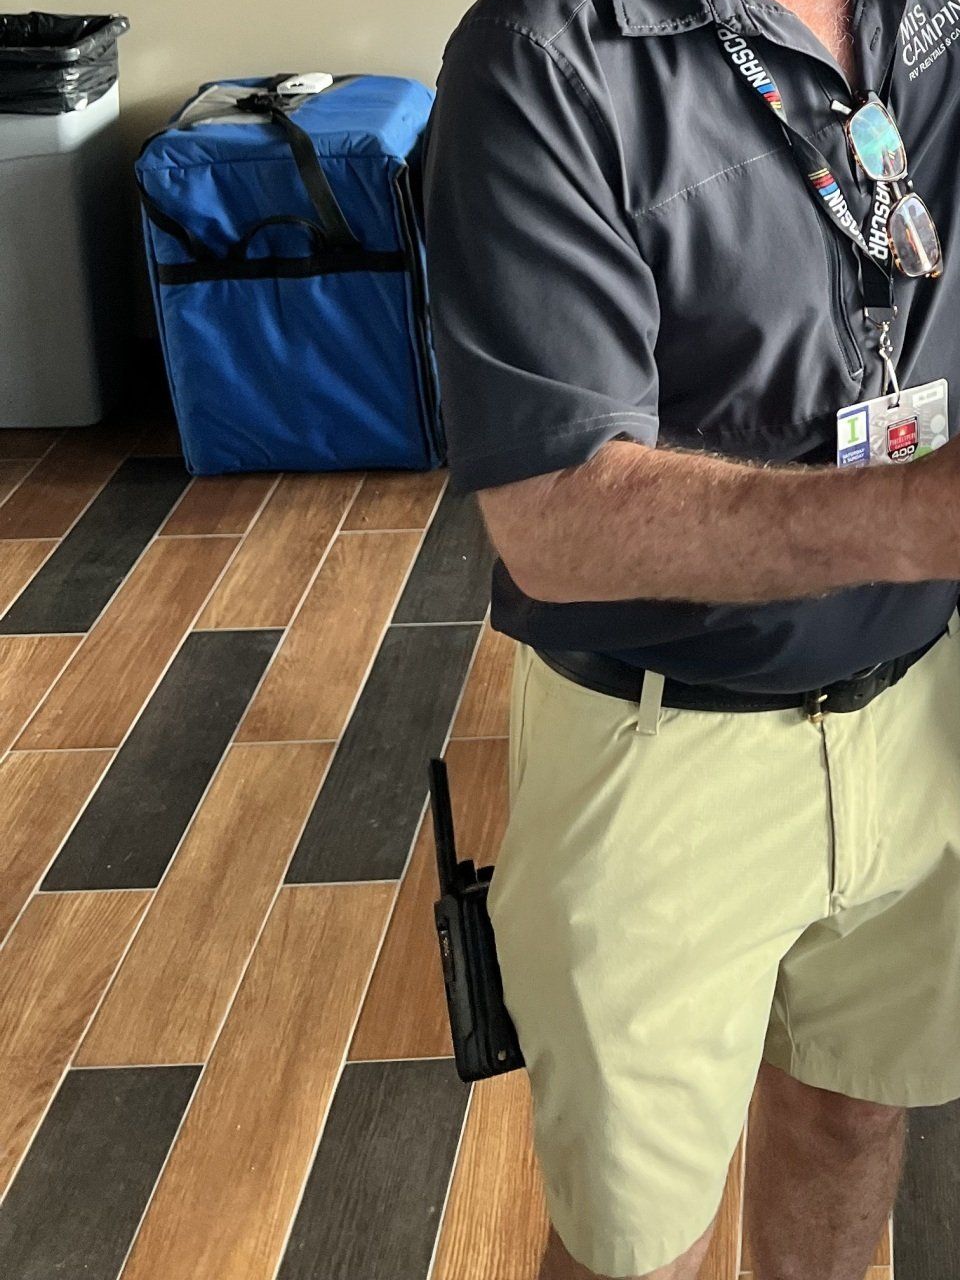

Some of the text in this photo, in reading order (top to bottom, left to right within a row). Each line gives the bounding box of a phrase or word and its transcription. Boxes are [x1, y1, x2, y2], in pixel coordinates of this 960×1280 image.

[909, 67, 919, 81] RV
[919, 43, 946, 72] RENTALS
[945, 37, 952, 46] &
[891, 445, 915, 459] 400
